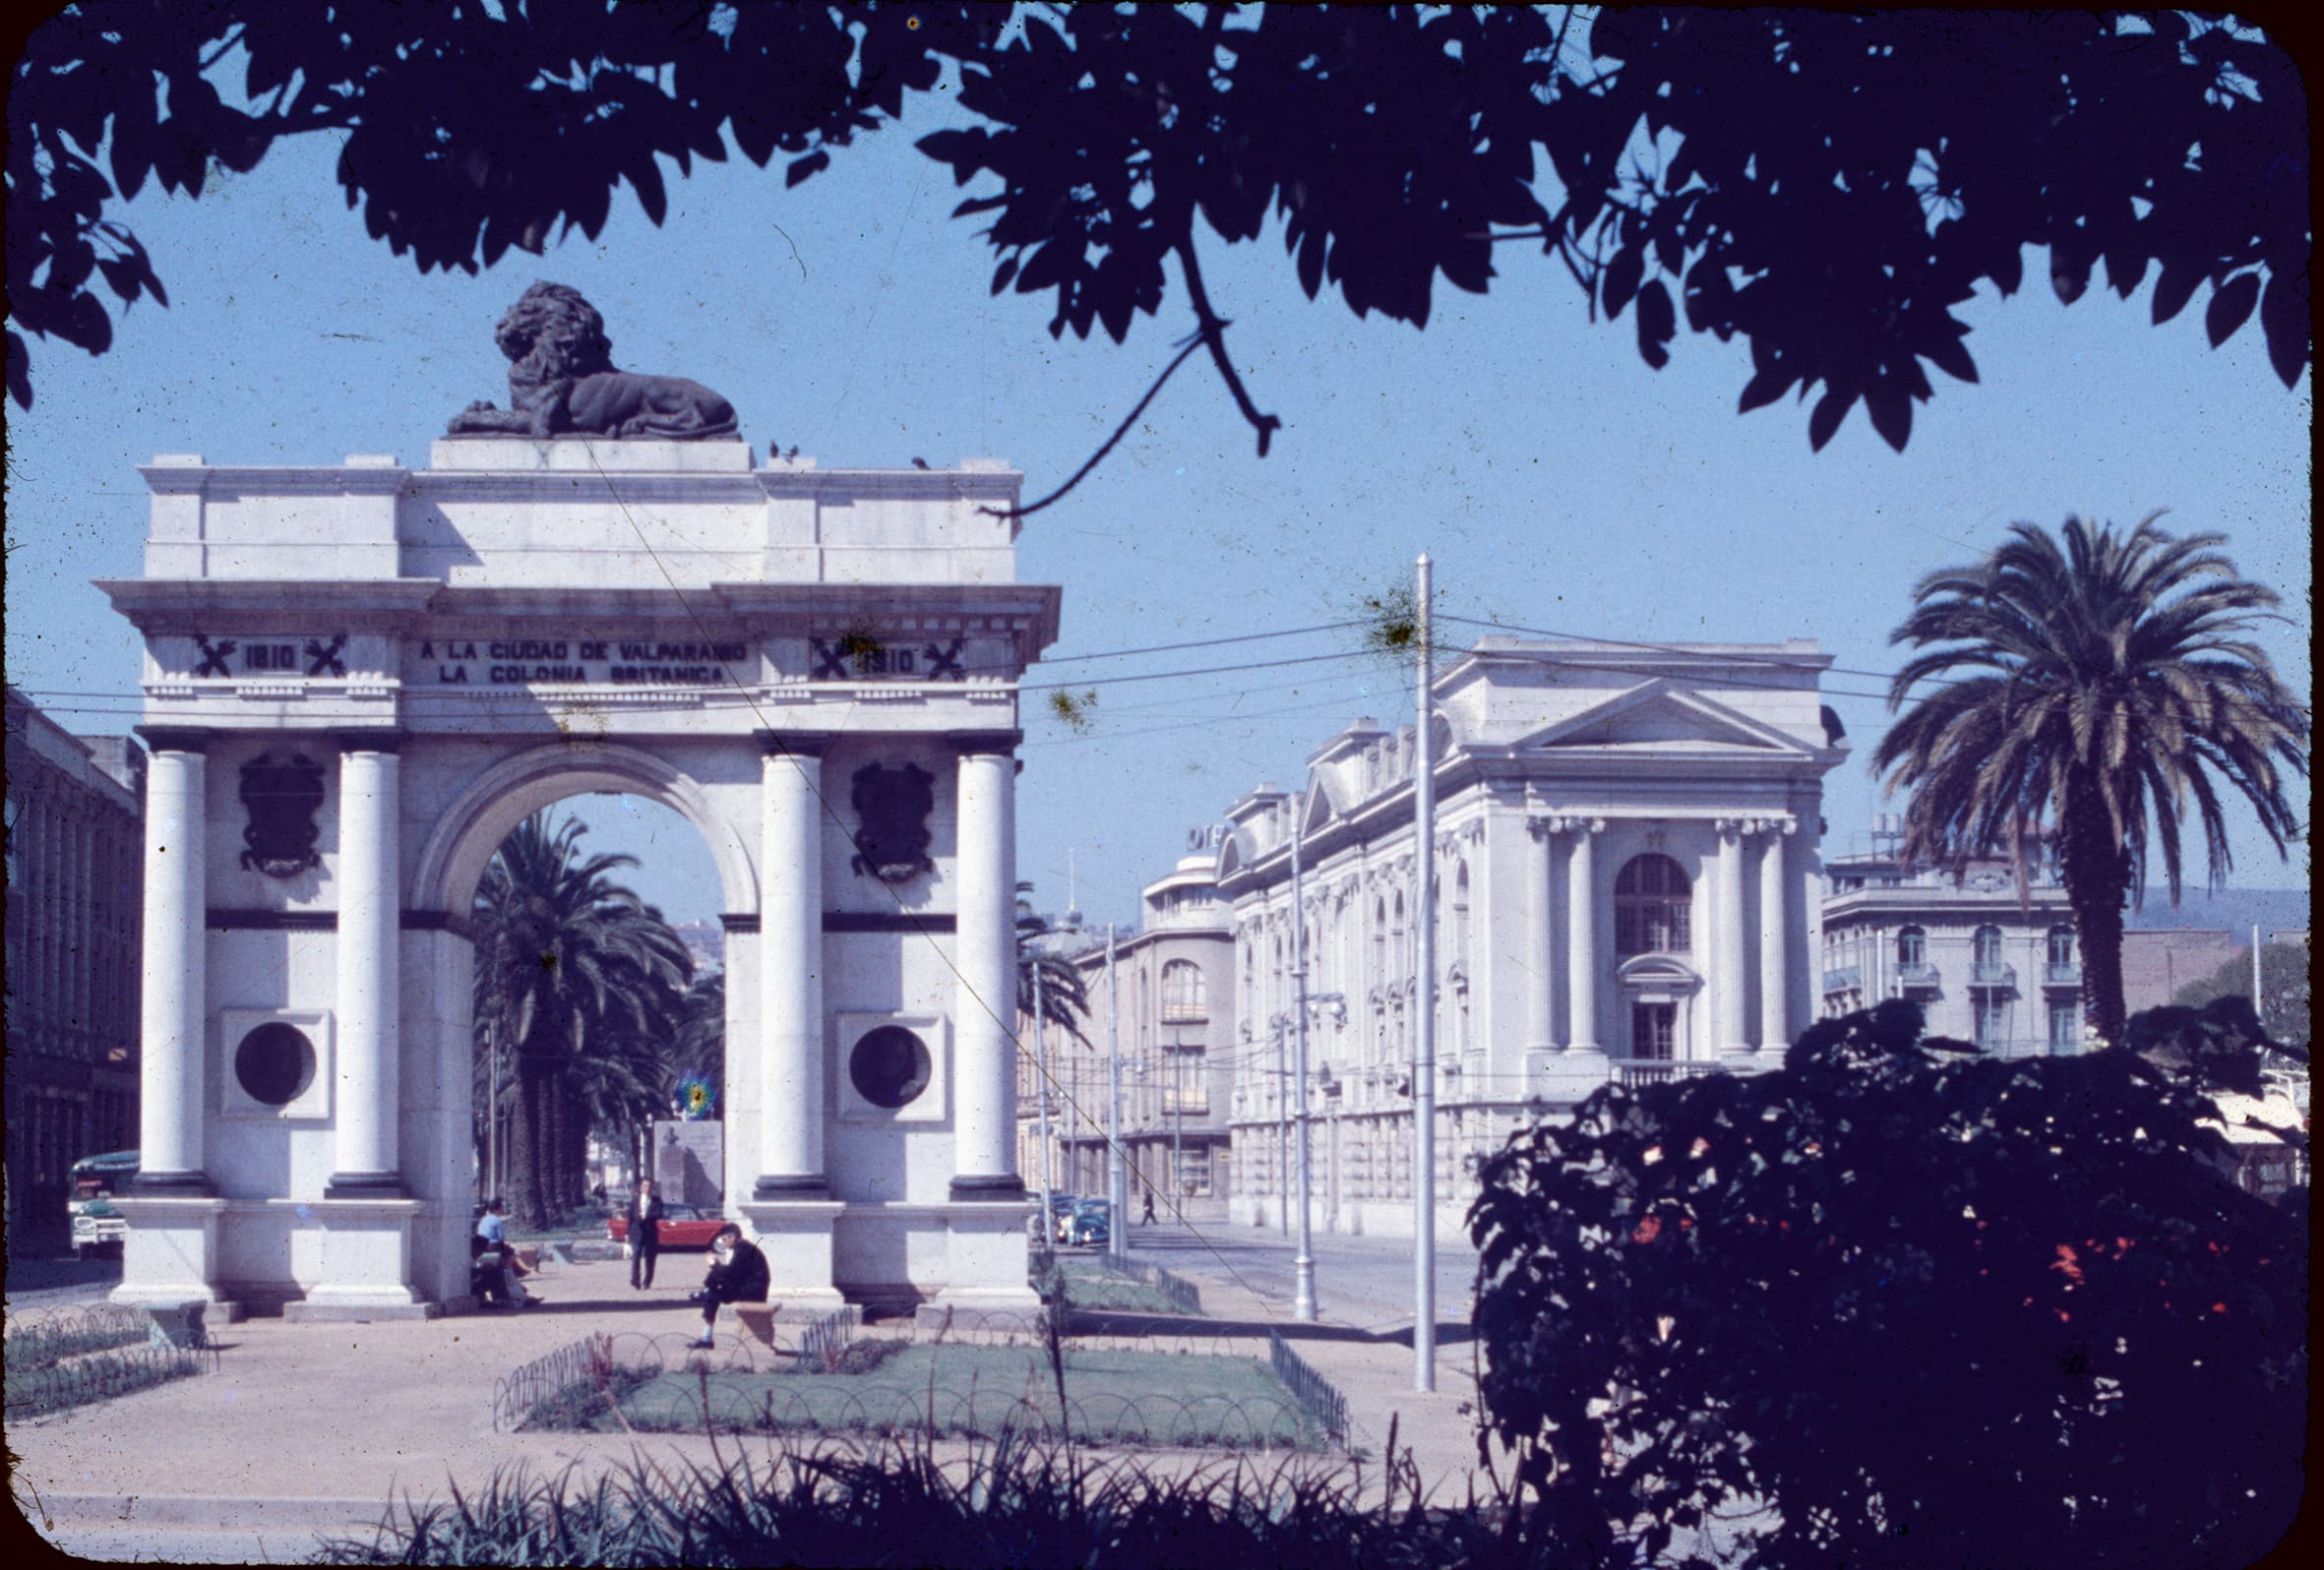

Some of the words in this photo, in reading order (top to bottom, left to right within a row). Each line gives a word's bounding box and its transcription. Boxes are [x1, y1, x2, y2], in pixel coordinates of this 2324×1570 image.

[421, 641, 435, 659] A
[448, 640, 477, 659] LA
[491, 642, 568, 660] CIUDAD
[580, 641, 608, 660] DE
[440, 665, 467, 684] LA
[491, 666, 586, 684] COLONIA
[611, 667, 724, 685] BRITANICA
